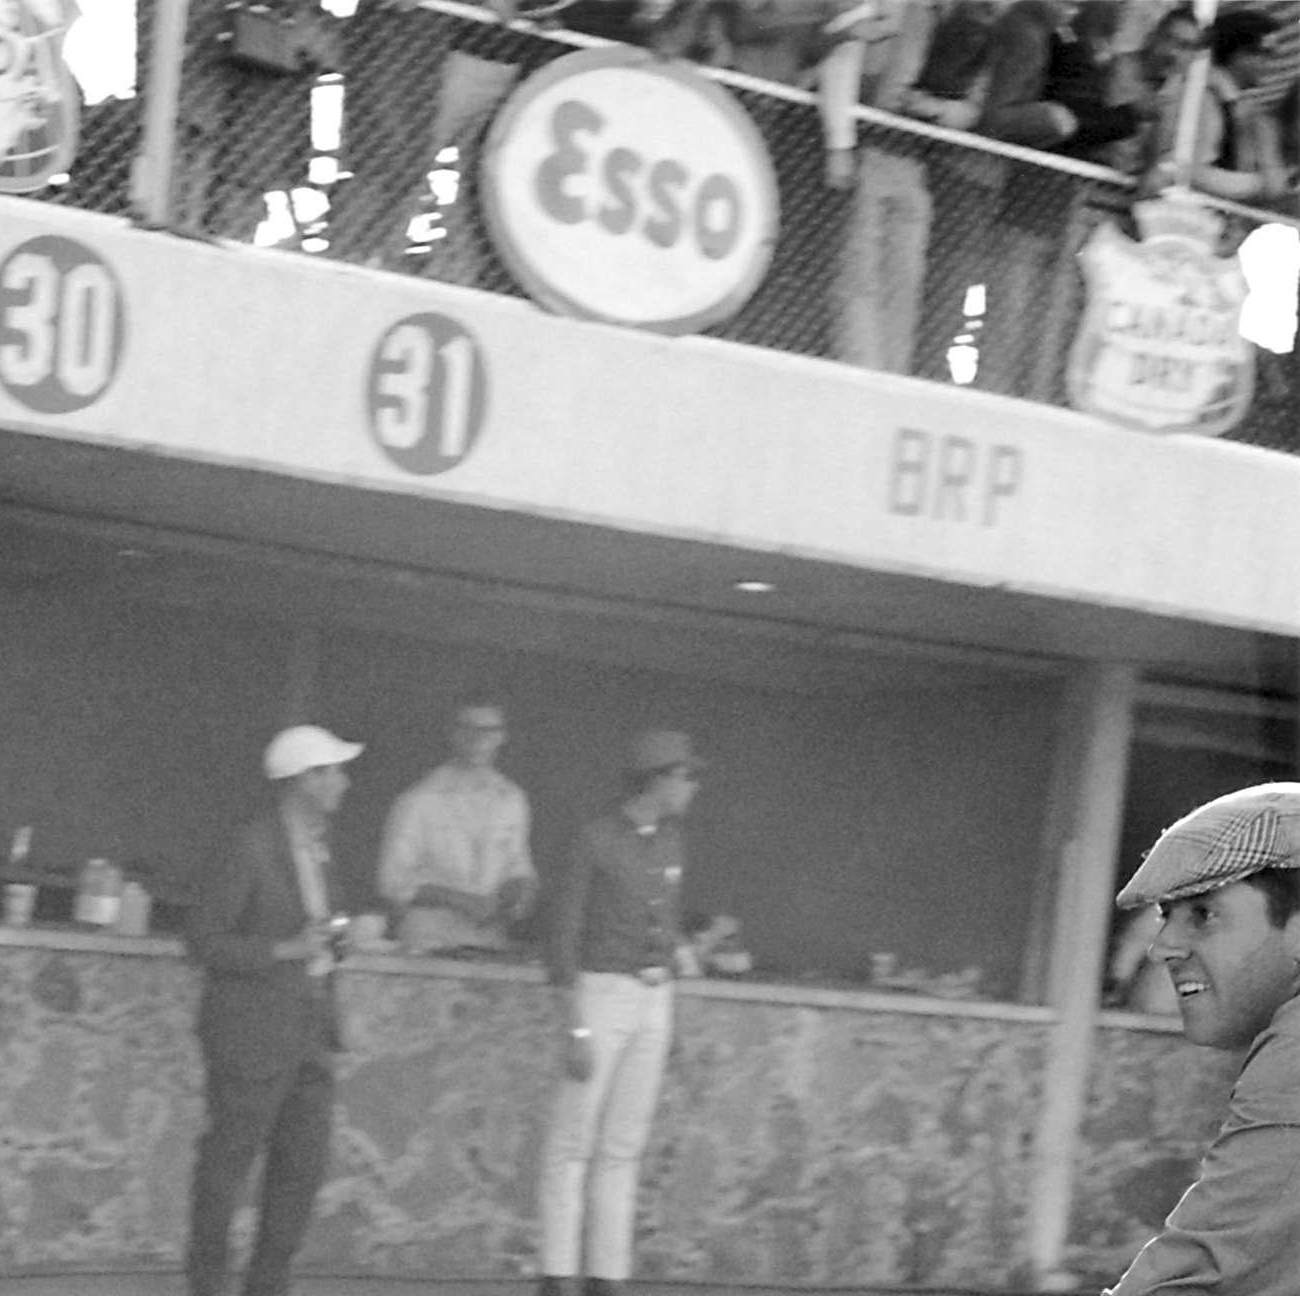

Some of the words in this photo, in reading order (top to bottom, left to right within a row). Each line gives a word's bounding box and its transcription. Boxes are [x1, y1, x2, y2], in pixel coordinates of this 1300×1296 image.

[535, 99, 742, 260] Esso
[0, 252, 117, 396] 30
[376, 325, 474, 458] 31
[888, 427, 1024, 526] BRP
